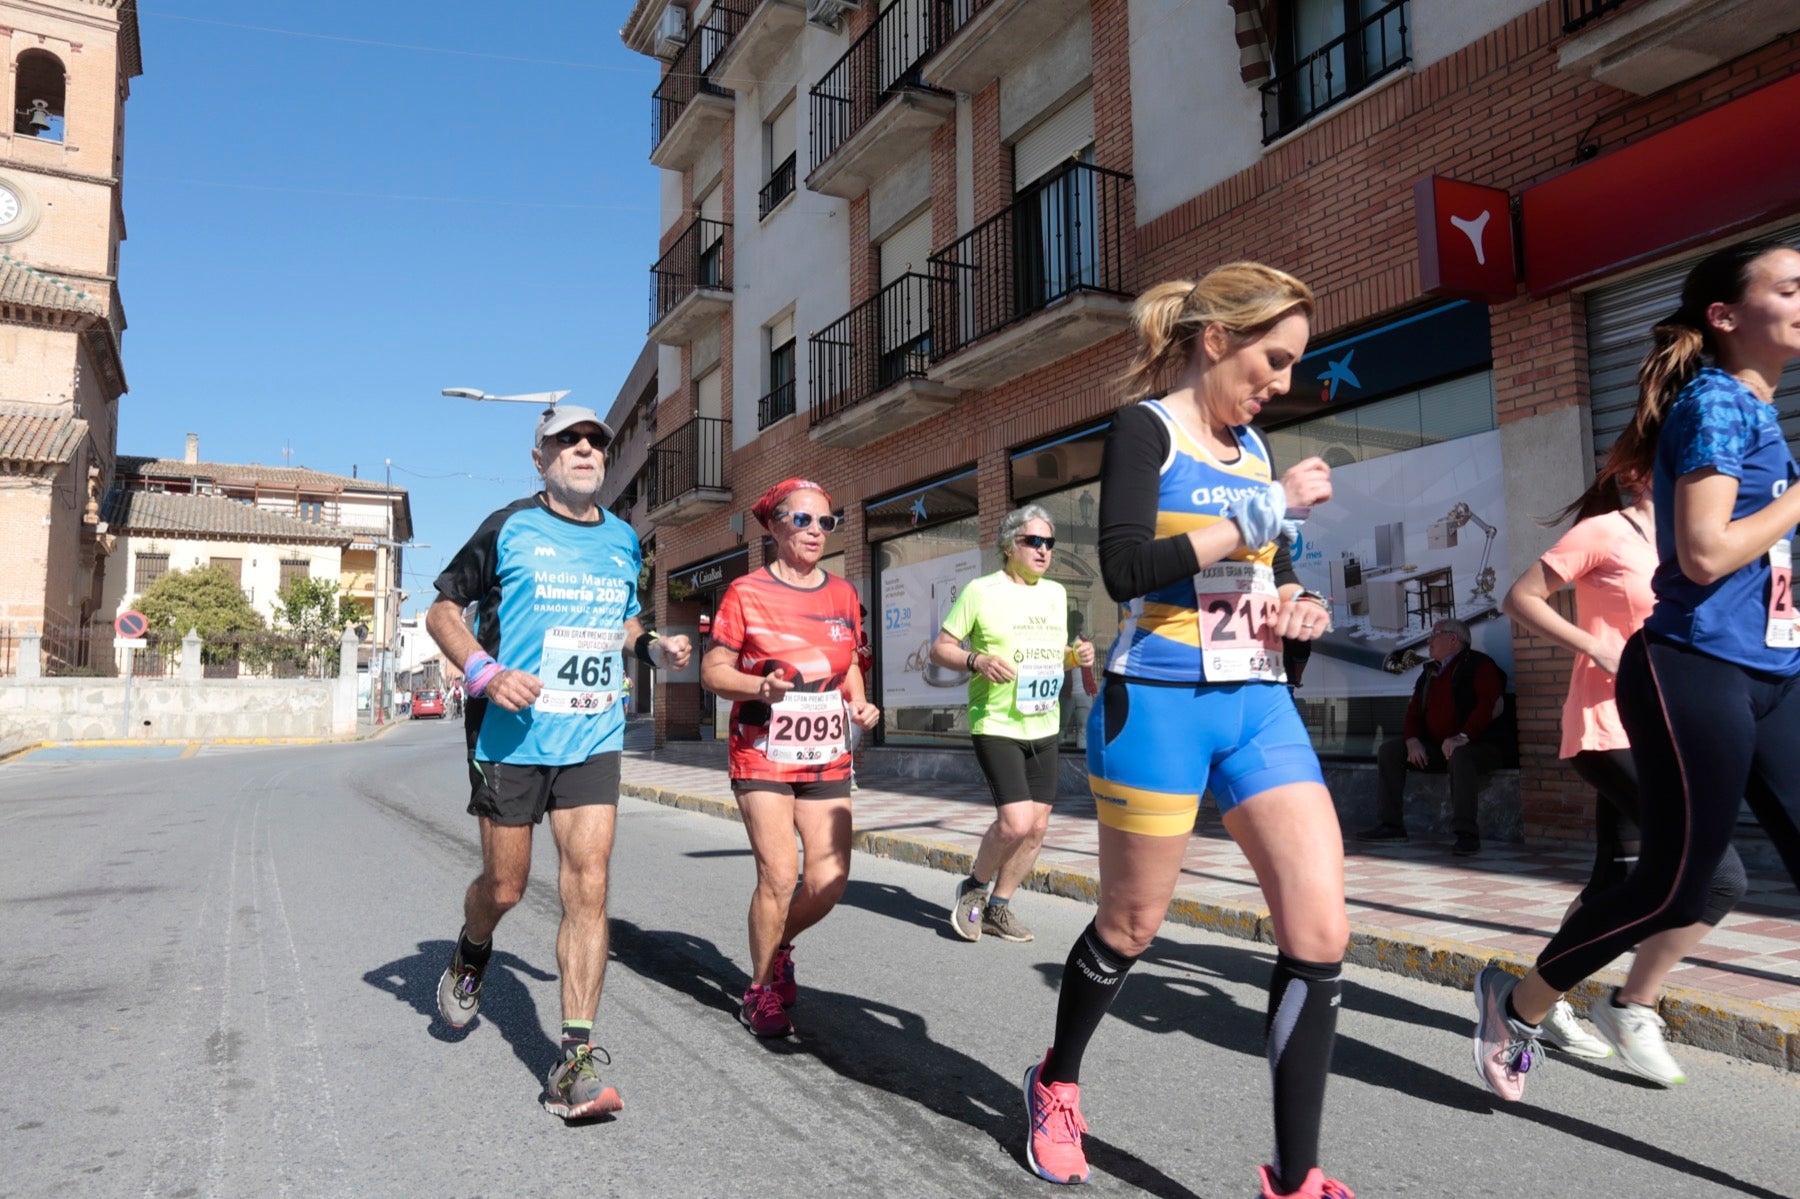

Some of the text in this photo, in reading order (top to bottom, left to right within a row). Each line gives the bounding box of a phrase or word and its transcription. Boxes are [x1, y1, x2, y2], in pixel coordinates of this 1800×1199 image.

[534, 570, 577, 584] Medio
[534, 584, 594, 602] Almería
[533, 603, 568, 613] RAMÓN
[557, 655, 612, 687] 465
[1028, 678, 1058, 698] 103
[774, 714, 842, 742] 2093
[1076, 958, 1119, 985] SPORTLAST
